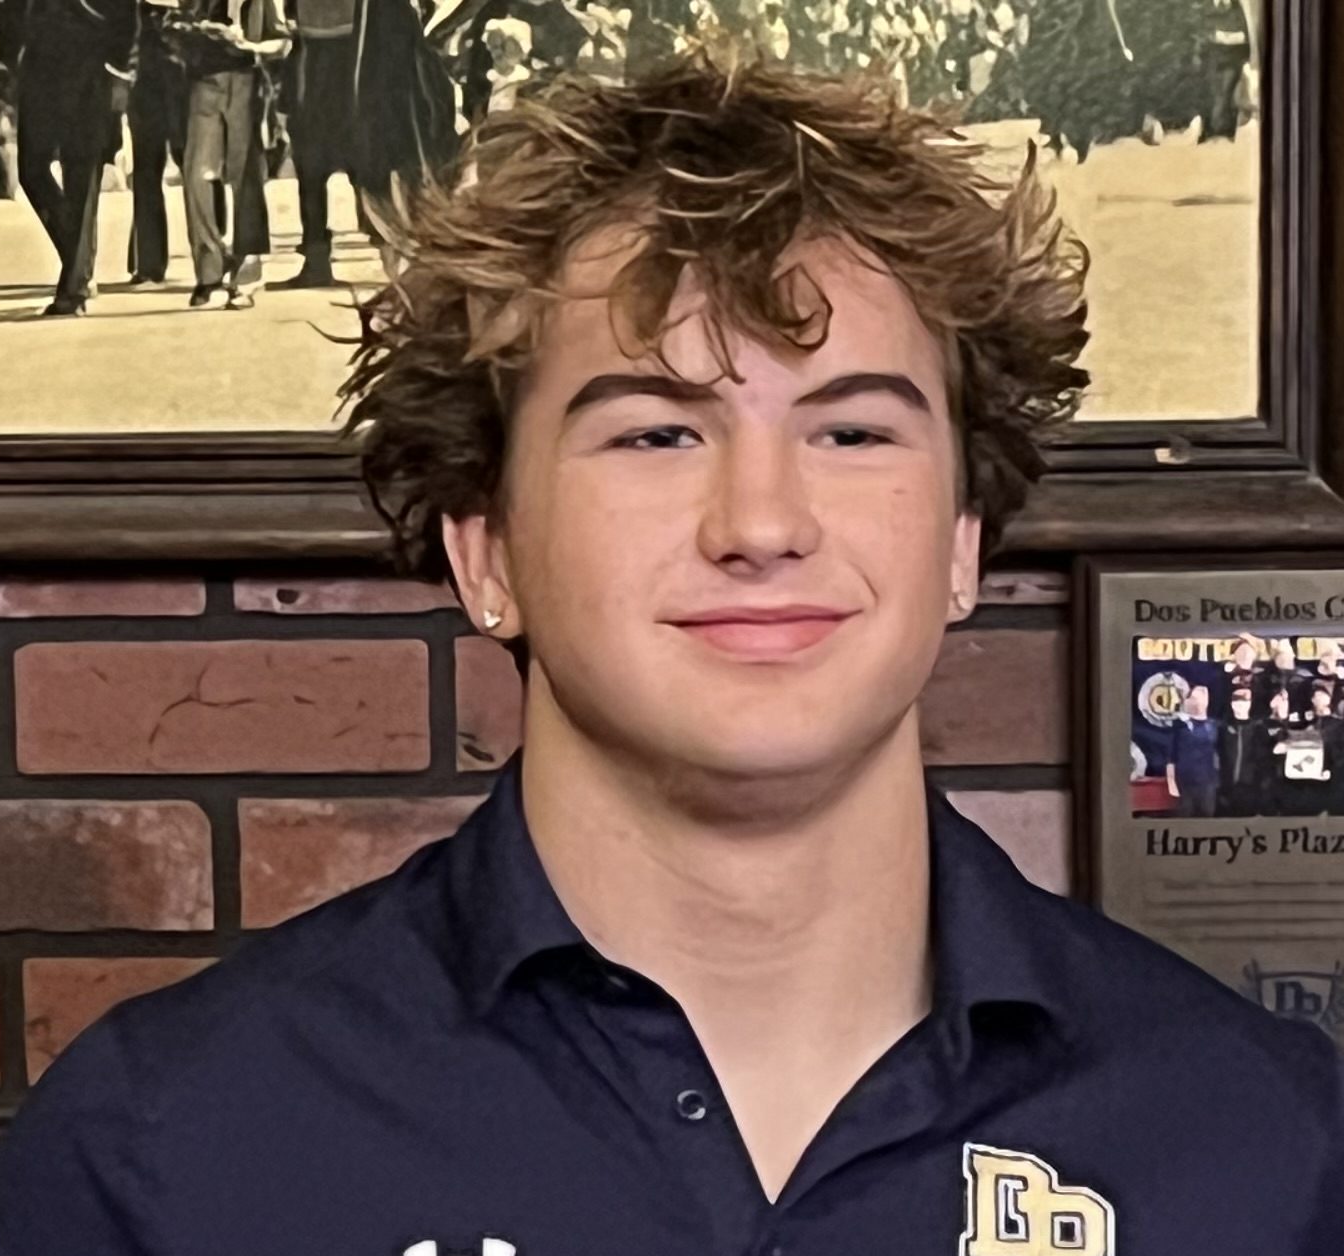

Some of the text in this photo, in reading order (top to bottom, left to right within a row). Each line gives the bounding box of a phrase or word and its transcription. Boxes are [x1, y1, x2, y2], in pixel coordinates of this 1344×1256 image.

[1134, 598, 1191, 623] Dos
[1199, 596, 1317, 623] Pueblos
[1145, 827, 1268, 864] Harry's
